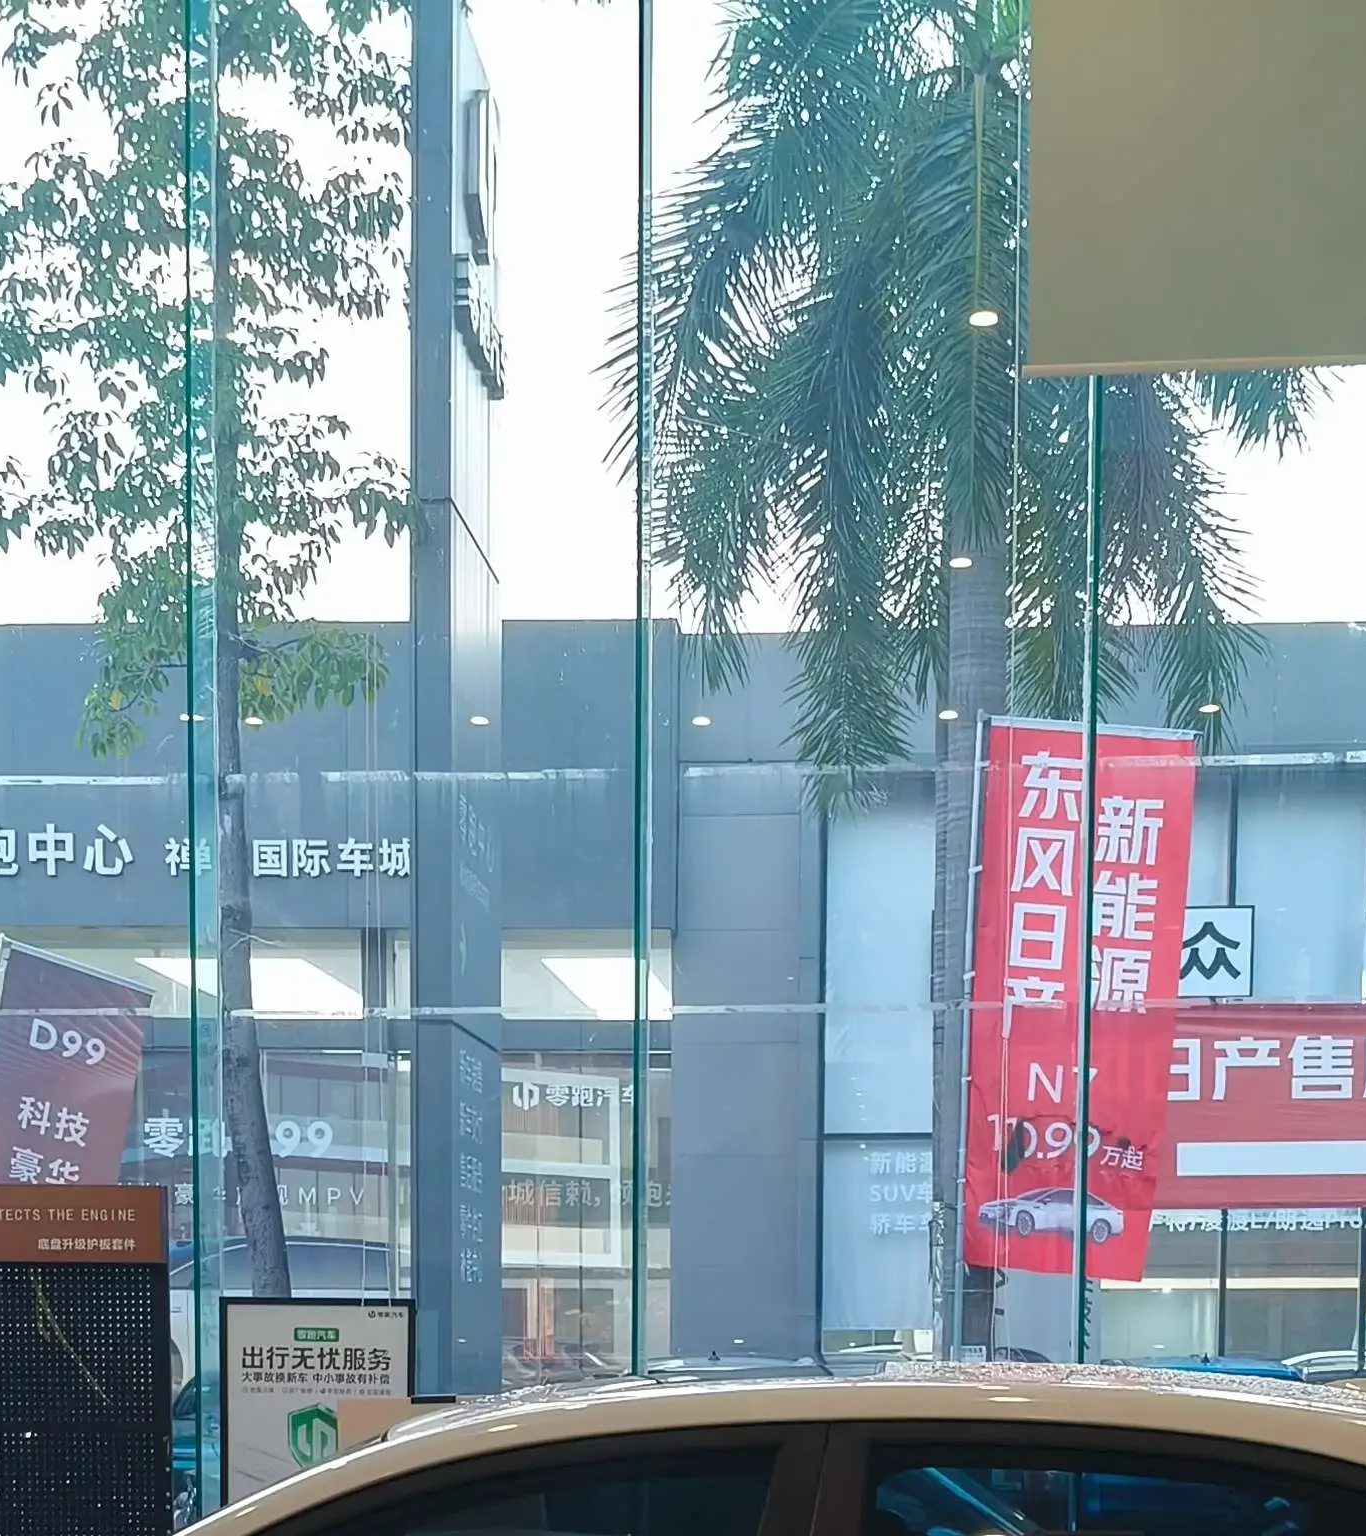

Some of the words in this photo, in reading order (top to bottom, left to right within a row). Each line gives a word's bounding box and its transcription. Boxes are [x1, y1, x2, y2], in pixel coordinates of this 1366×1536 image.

[164, 837, 411, 877] 禅国际车城
[1002, 750, 1082, 1037] 东风日产
[1090, 796, 1164, 1014] 新能源
[1180, 921, 1241, 980] 众
[29, 1018, 106, 1065] D99
[17, 1096, 90, 1148] 科技
[9, 1146, 80, 1185] 豪华
[49, 1208, 73, 1222] THE
[81, 1208, 136, 1222] ENGINE
[38, 1238, 136, 1252] 底盘升级护板套件
[242, 1346, 392, 1371] 出行无忧服务
[242, 1372, 308, 1385] 大事故换新车
[313, 1372, 391, 1385] 中小事故有补偿
